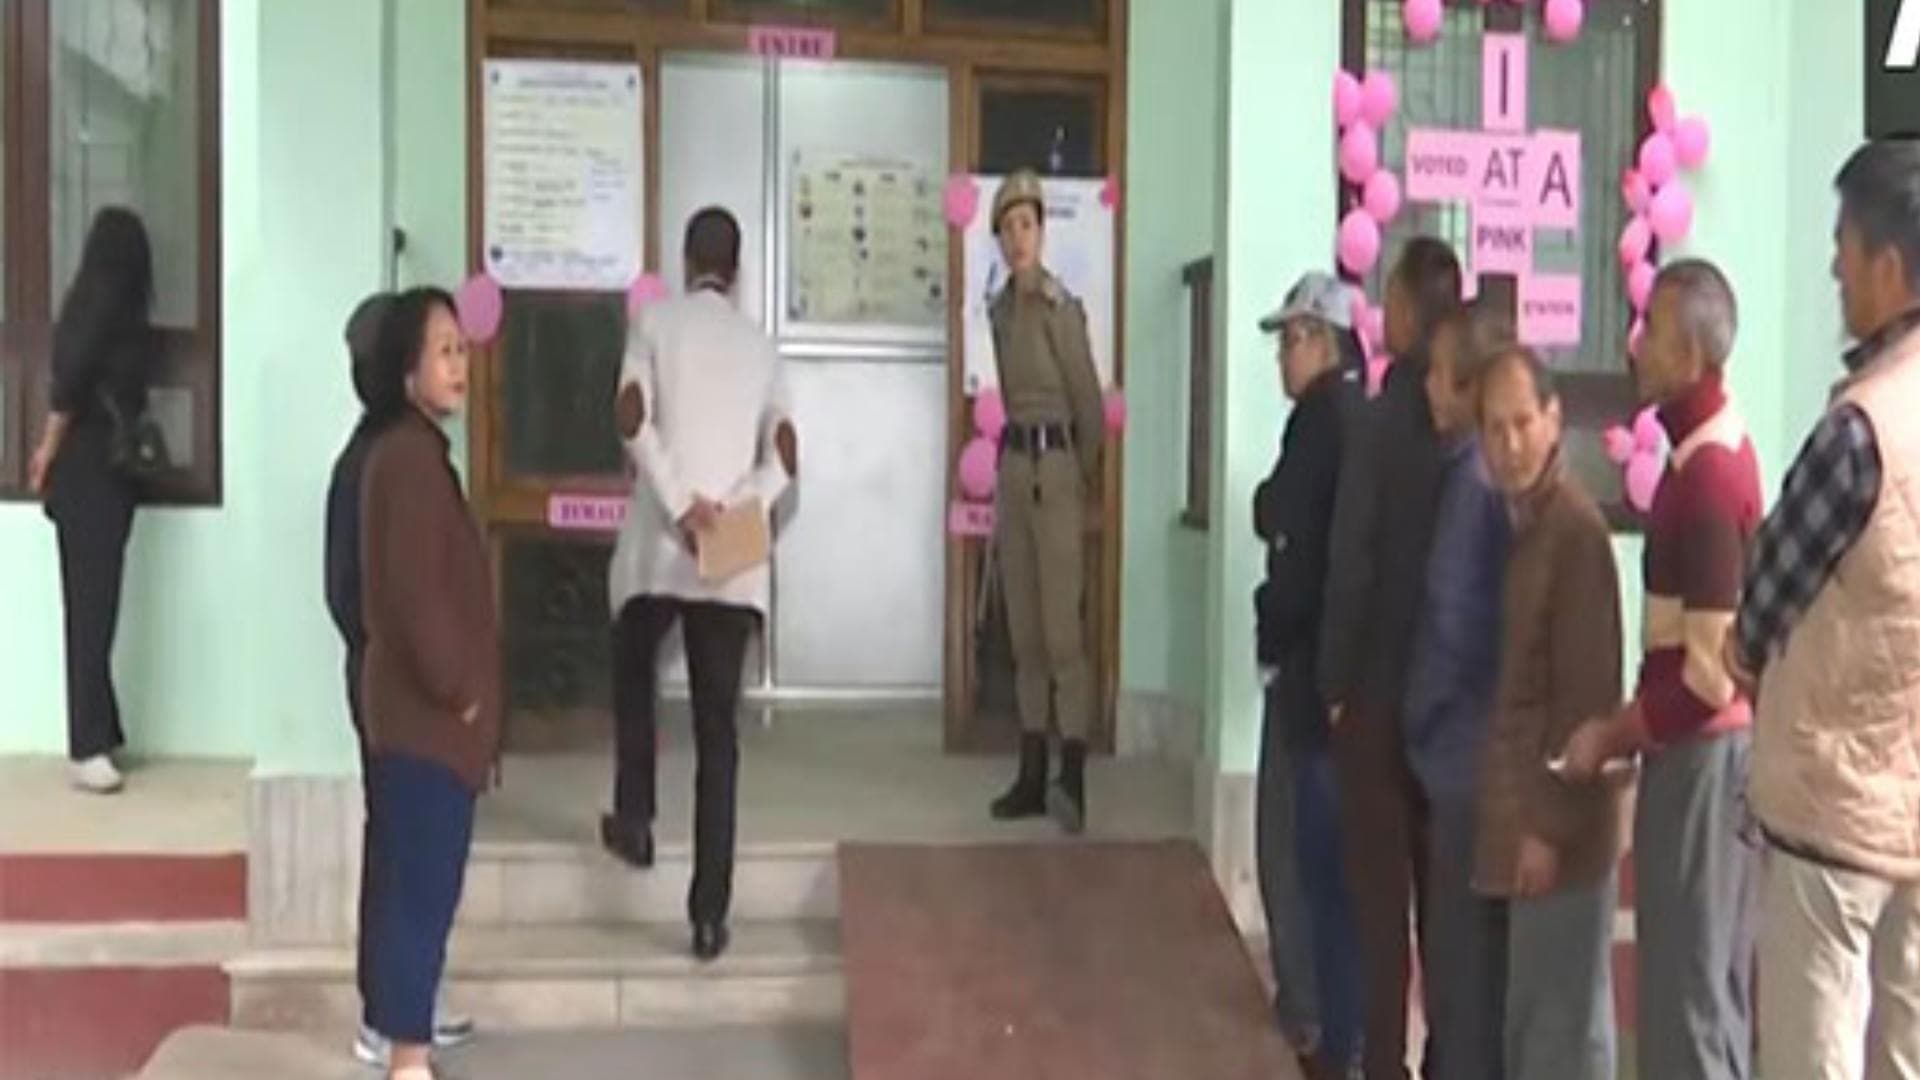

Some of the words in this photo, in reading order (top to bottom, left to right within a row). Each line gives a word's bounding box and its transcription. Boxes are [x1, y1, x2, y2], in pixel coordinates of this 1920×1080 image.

[1500, 49, 1509, 116] I
[1412, 154, 1468, 177] VOTED
[1482, 147, 1525, 188] AT
[1539, 151, 1572, 208] A
[1476, 225, 1526, 252] PINK
